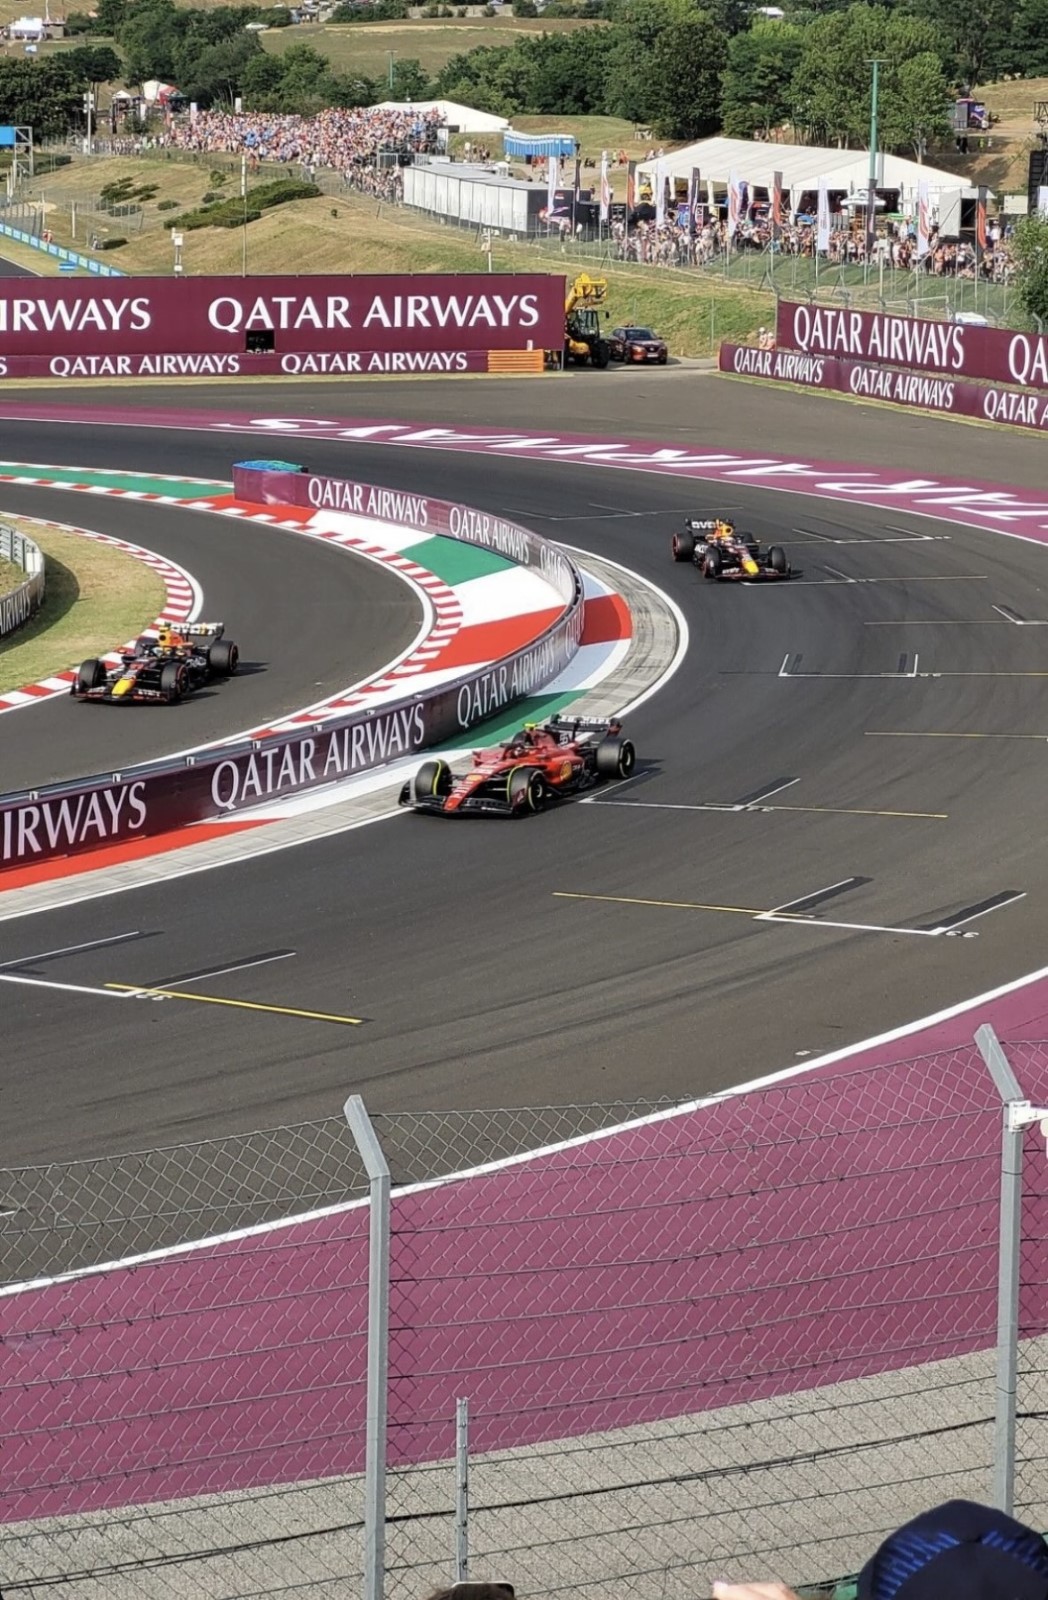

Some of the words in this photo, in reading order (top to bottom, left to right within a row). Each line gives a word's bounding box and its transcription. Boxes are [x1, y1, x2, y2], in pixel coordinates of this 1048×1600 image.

[208, 296, 352, 334] QATAR
[362, 294, 539, 328] AIRWAYS
[793, 305, 863, 355] QATAR
[867, 315, 965, 369] AIRWAYS
[49, 356, 132, 377] QATAR
[138, 354, 240, 374] AIRWAYS
[281, 352, 362, 374] QATAR
[367, 351, 468, 371] AIRWAYS
[734, 347, 772, 376] QATAR
[774, 353, 825, 383] AIRWAYS
[849, 366, 891, 398] QATAR
[892, 374, 955, 409] AIRWAYS
[983, 389, 1038, 425] QATAR
[308, 477, 364, 512] QATAR
[366, 487, 428, 526] AIRWAYS
[449, 506, 490, 546] QATAR
[492, 519, 530, 564] AIRWAYS
[457, 665, 508, 728] QATAR
[510, 636, 555, 699] AIRWAYS
[211, 738, 316, 810] QATAR
[323, 702, 425, 777] AIRWAYS
